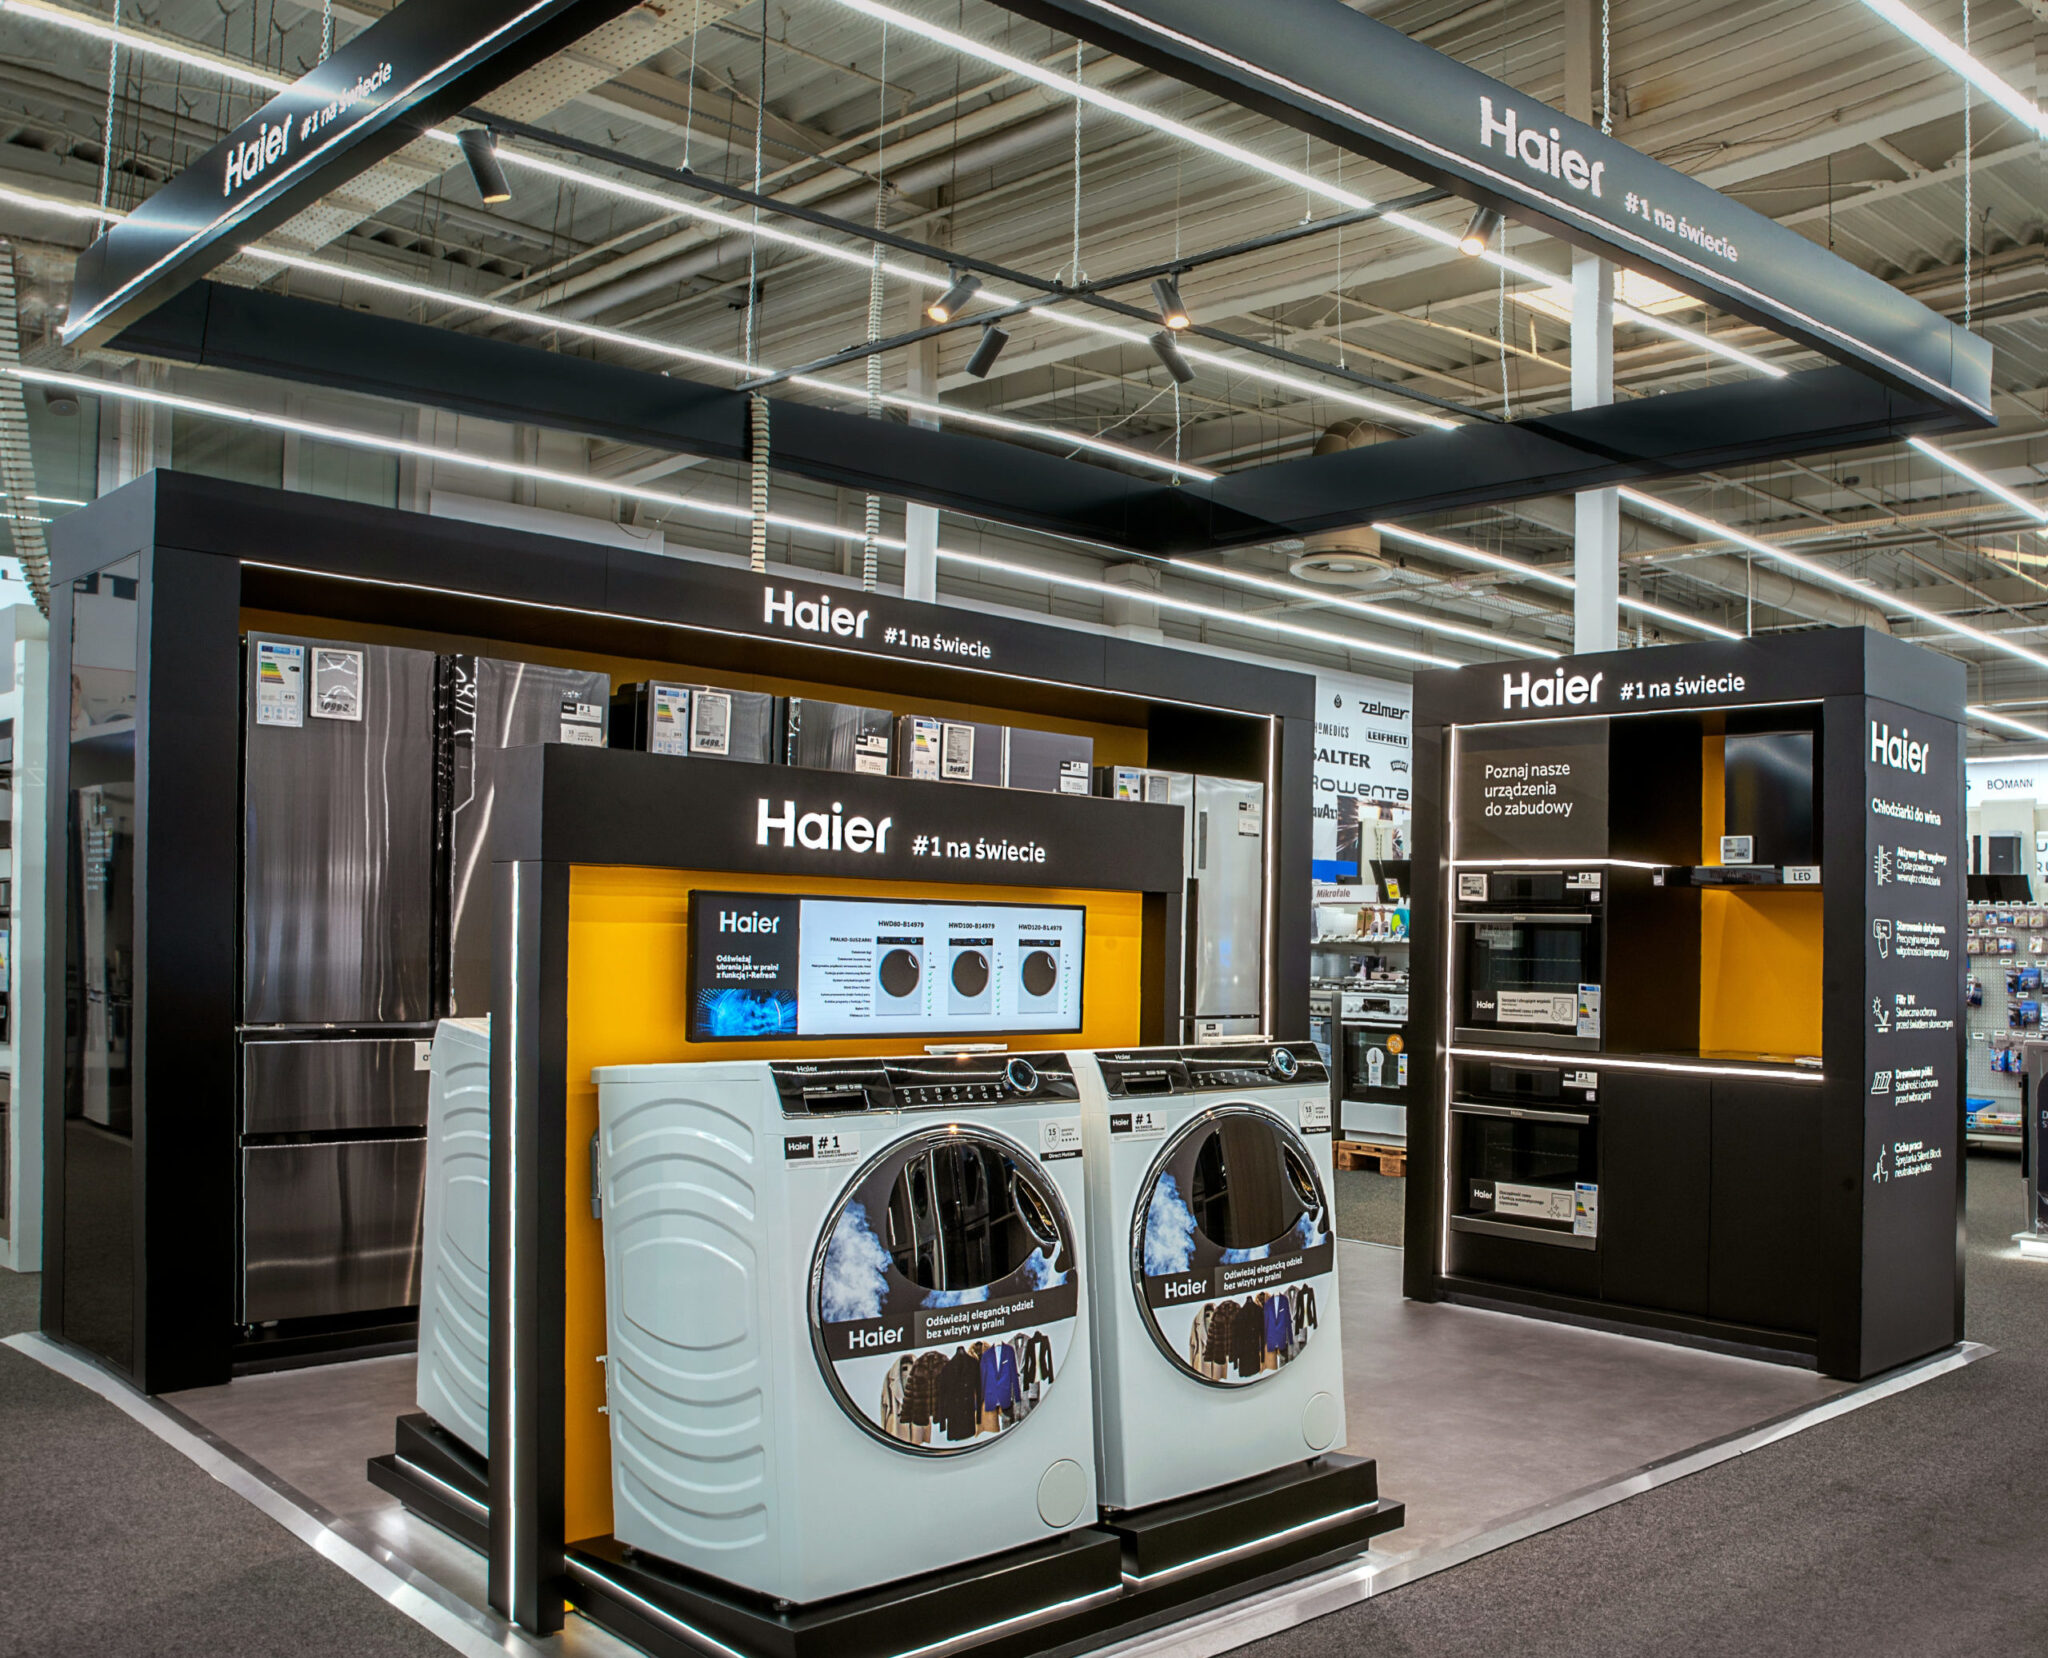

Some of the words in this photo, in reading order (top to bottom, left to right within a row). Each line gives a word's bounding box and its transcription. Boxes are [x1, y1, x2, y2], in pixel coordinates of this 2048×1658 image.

[224, 113, 293, 197] Haier
[300, 110, 320, 142] #1
[320, 101, 338, 128] na
[339, 62, 392, 114] świecie
[1480, 96, 1605, 198] Haier
[1624, 191, 1650, 222] #1
[1655, 208, 1676, 233] na
[1678, 216, 1739, 263] świecie
[763, 586, 870, 639] Haier
[884, 627, 907, 646] #1
[911, 632, 930, 649] na
[933, 633, 992, 659] świecie
[1502, 667, 1603, 710] Haier
[1620, 682, 1646, 700] #1
[1649, 679, 1671, 699] na
[1674, 673, 1746, 696] świecie
[1359, 701, 1410, 720] zelmer
[1367, 731, 1408, 746] LEIFHEIT
[1871, 720, 1930, 775] Haier
[1485, 762, 1529, 781] Poznaj
[1531, 764, 1570, 777] nasze
[1485, 781, 1557, 800] urządzenia
[1987, 778, 2033, 790] BOMANN
[1485, 801, 1503, 817] do
[1504, 799, 1573, 818] zabudowy
[1871, 797, 1914, 821] Chłodziarki
[1914, 806, 1924, 823] do
[1924, 809, 1941, 826] wina
[756, 798, 893, 854] Haier
[911, 835, 941, 858] #1
[946, 840, 971, 859] na
[974, 837, 1047, 863] świecie
[1793, 872, 1811, 881] LED
[1316, 888, 1351, 899] Mikrofale
[719, 910, 781, 934] Haier
[742, 963, 752, 972] jak
[1476, 1000, 1495, 1009] Haier
[1112, 1118, 1129, 1127] Haier
[1135, 1113, 1144, 1125] #
[1146, 1112, 1153, 1124] 1
[1048, 1127, 1057, 1136] 15
[787, 1142, 810, 1152] Haier
[817, 1135, 829, 1149] #
[832, 1135, 841, 1148] 1
[1473, 1188, 1493, 1200] Haier
[1223, 1265, 1256, 1281] Odświeżaj
[1256, 1261, 1286, 1274] elegancką
[1286, 1256, 1303, 1268] odzież
[1164, 1279, 1207, 1299] Haier
[1223, 1281, 1236, 1291] bez
[1237, 1277, 1257, 1288] wizyty
[1257, 1276, 1264, 1284] w
[1264, 1270, 1282, 1285] pralni
[926, 1310, 970, 1328] Odświeżaj
[971, 1304, 1011, 1320] elegancką
[1011, 1298, 1035, 1313] odzież
[849, 1325, 904, 1350] Haier
[926, 1329, 942, 1340] bez
[943, 1324, 972, 1337] wizyty
[972, 1322, 980, 1332] w
[981, 1316, 1005, 1332] pralni
